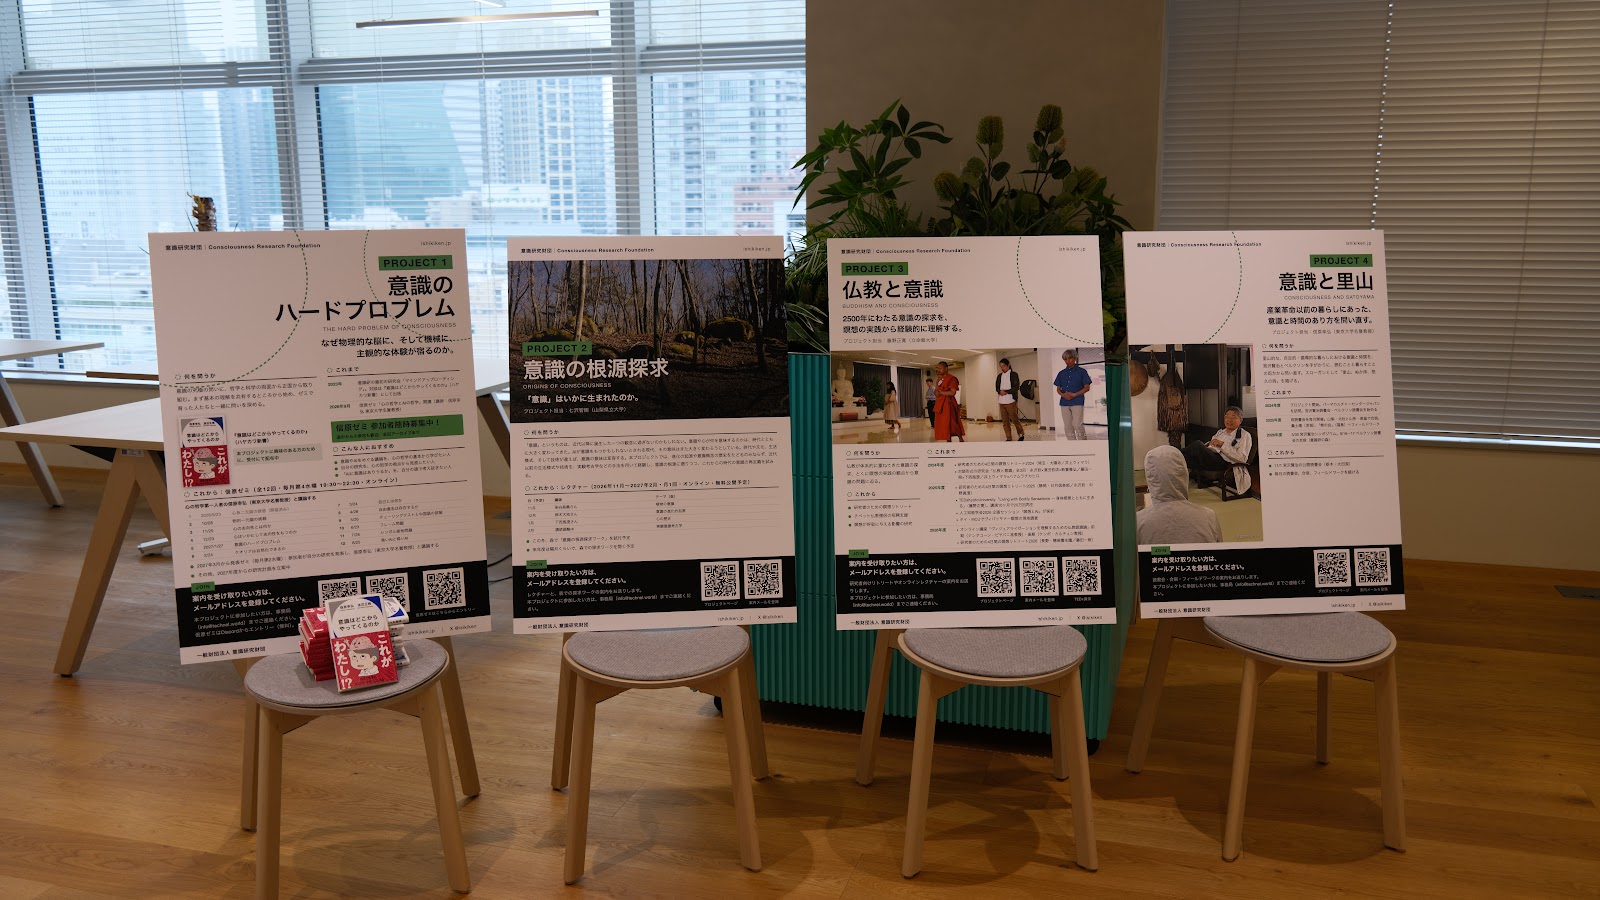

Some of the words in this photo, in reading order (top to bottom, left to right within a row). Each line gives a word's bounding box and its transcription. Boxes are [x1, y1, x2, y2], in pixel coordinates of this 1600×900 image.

[384, 258, 438, 268] PROJECT
[442, 258, 446, 266] 1
[387, 274, 453, 296] 意識の
[1278, 272, 1373, 291] 意識と里山
[842, 279, 944, 300] 仏教と意識
[275, 298, 455, 321] ハードプロブレム
[1266, 306, 1372, 314] 産業革命以前の暮らしにあった、
[842, 314, 948, 323] 2500年にわたる意識の探求を、
[1268, 316, 1373, 325] 意識と時間のあり方を問い直す。
[843, 324, 962, 333] 瞑想の実践から経験的に理解する。
[322, 334, 453, 347] なぜ物理的な脳に、そして機械に、
[356, 346, 454, 358] 主観的な体験が宿るのか。
[523, 358, 669, 380] 意識の根源探求
[527, 394, 639, 403] 「意識」はいかに生まれたのか。
[336, 422, 368, 432] 信原ゼミ
[370, 418, 439, 430] 参加者随時募集中！
[217, 448, 227, 474] これが
[849, 559, 918, 567] 案内を受け取りたい方は、
[1152, 564, 1245, 572] メールアドレスを登録してください。
[527, 569, 597, 578] 案内を受け取りたい方は、
[849, 568, 946, 576] メールアドレスを登録してください。
[527, 577, 626, 587] メールアドレスを登録してください。
[192, 588, 272, 602] 案内を受け取りたい方は、
[194, 595, 306, 611] メールアドレスを登録してください。
[338, 615, 378, 625] 意識はどこから
[340, 621, 379, 631] やってくるのか
[378, 634, 392, 668] これが
